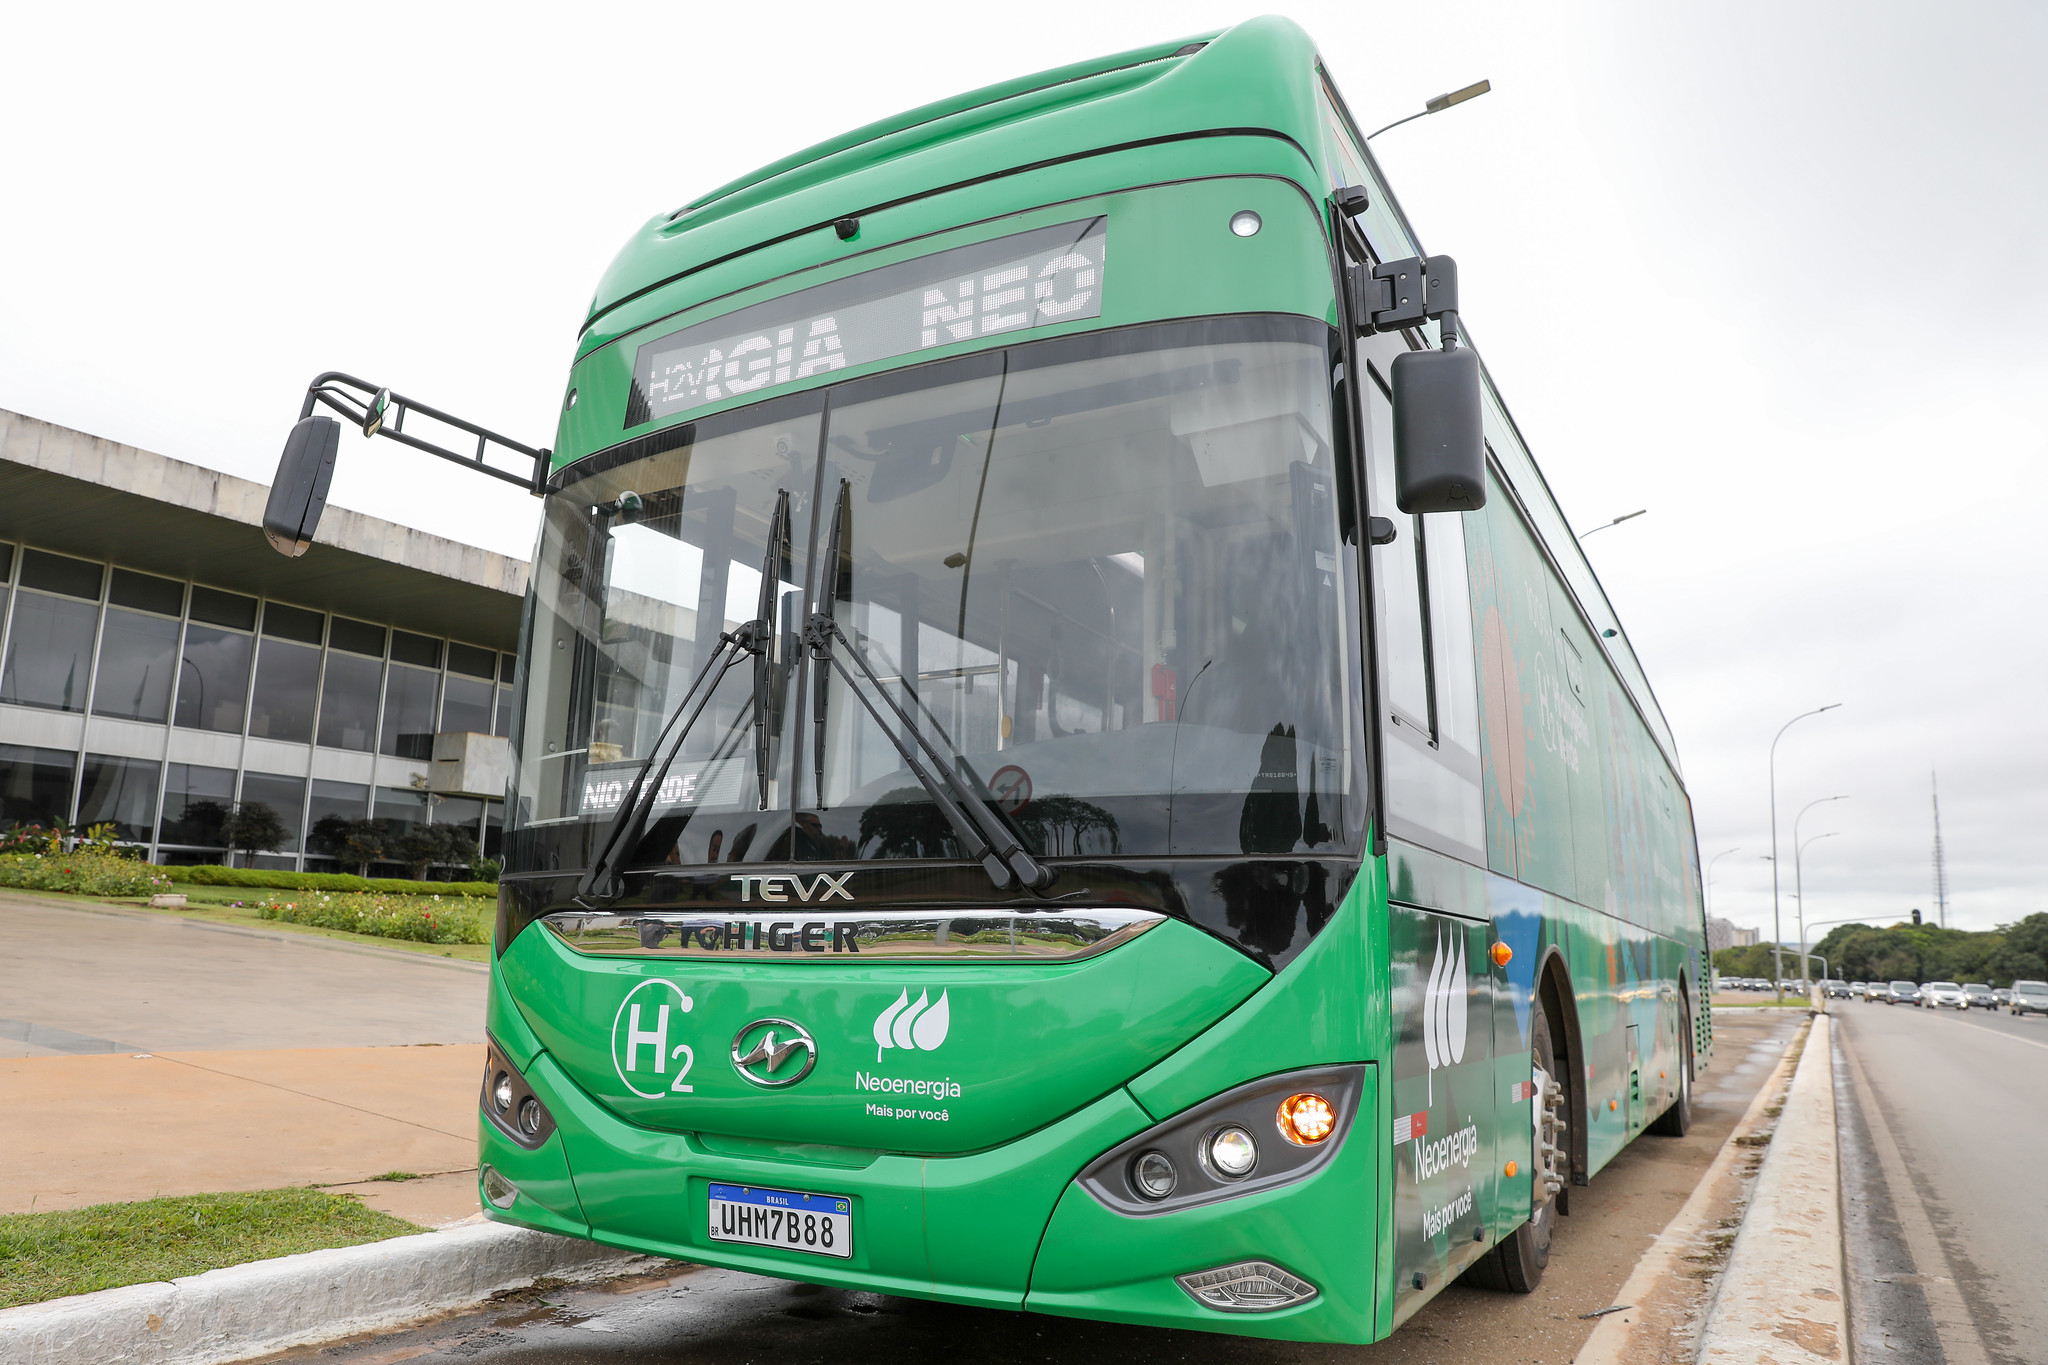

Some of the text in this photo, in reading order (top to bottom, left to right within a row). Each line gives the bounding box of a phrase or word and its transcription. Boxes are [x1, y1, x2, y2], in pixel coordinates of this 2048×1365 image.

[922, 245, 1105, 347] NEO
[730, 871, 855, 902] TEVX
[723, 921, 860, 953] HIGER
[626, 1003, 694, 1093] H2
[855, 1071, 961, 1101] Neoenergia
[866, 1103, 950, 1122] Mais por você
[1415, 1114, 1477, 1185] Neoenergia
[766, 1195, 789, 1206] BRASIL
[1423, 1184, 1472, 1243] Mais por você
[711, 1225, 720, 1236] BR
[721, 1203, 834, 1248] UHM7B88
